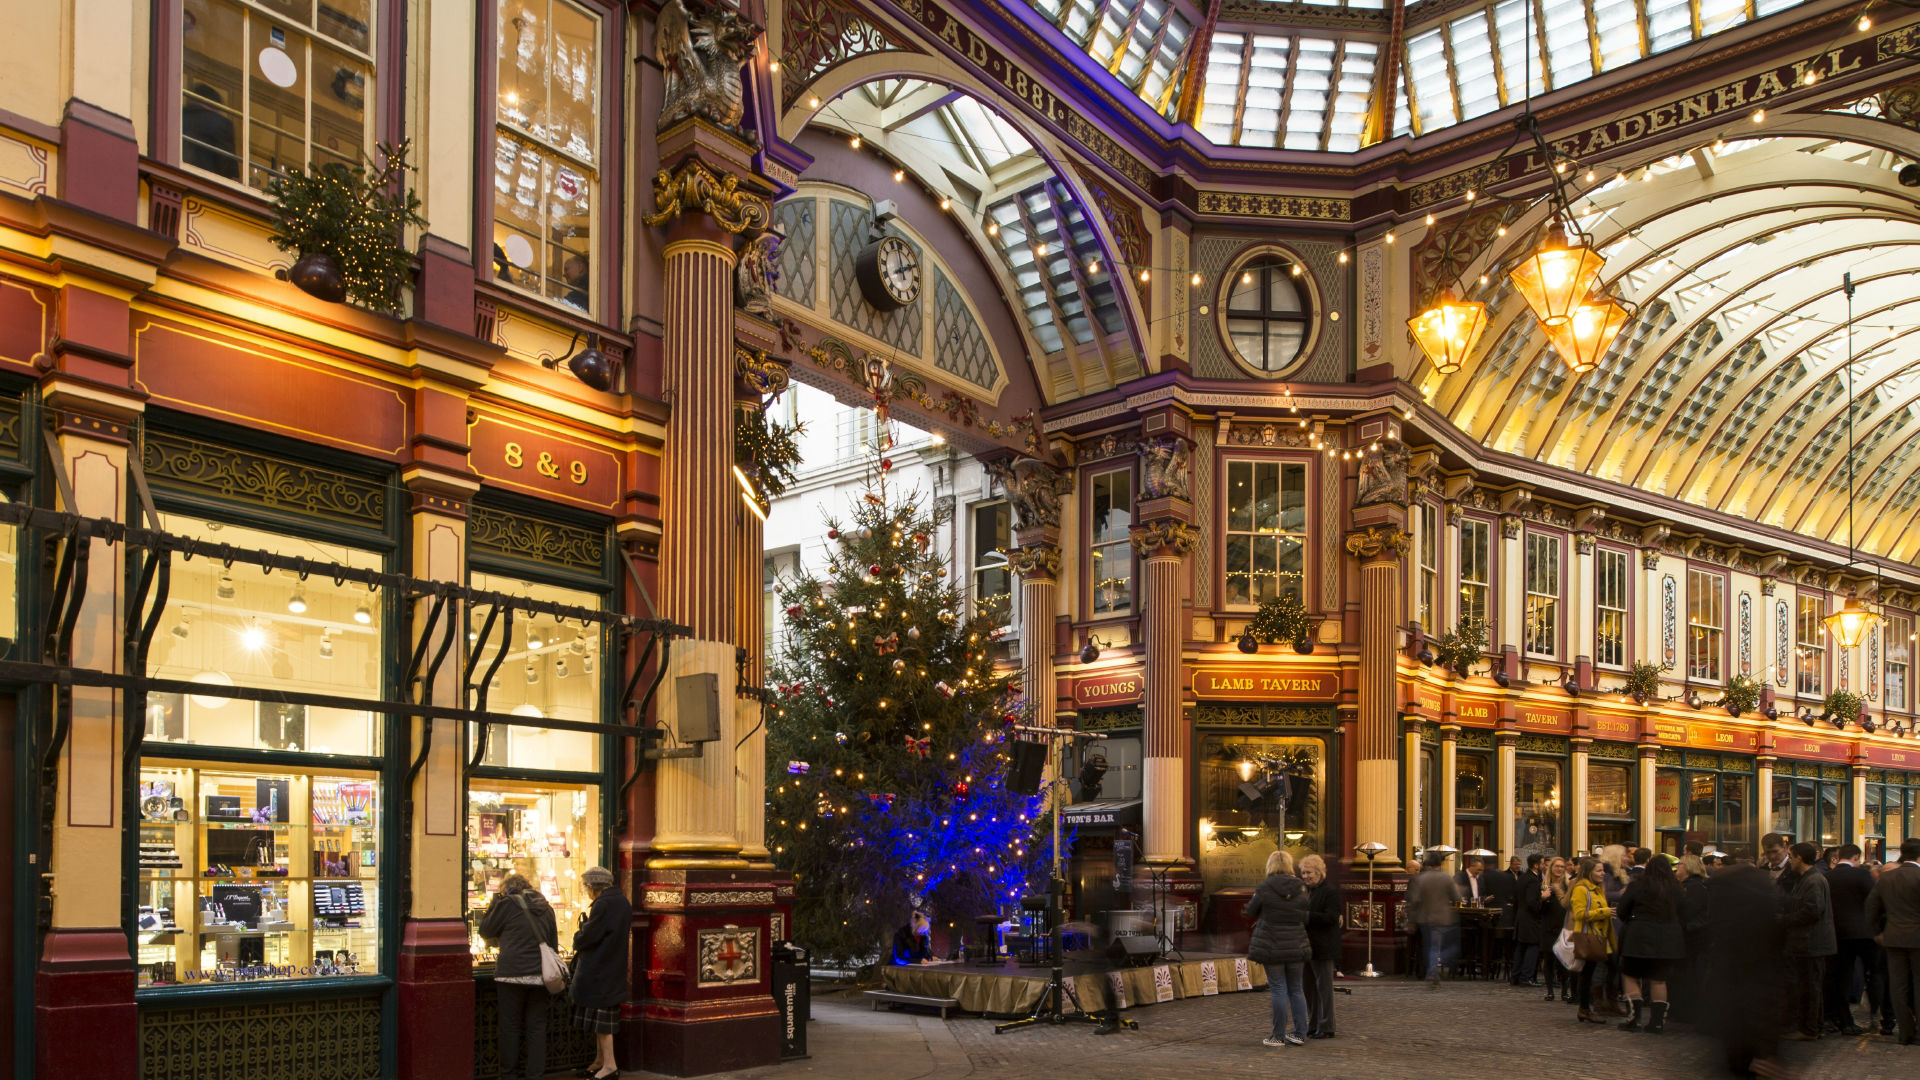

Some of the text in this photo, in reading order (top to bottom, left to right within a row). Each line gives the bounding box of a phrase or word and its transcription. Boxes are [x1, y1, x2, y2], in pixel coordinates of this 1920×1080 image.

[1003, 60, 1056, 122] 1881
[1523, 48, 1862, 174] LEADENHALL
[504, 442, 588, 485] 8 & 9
[1084, 681, 1136, 698] YOUNGS
[1210, 677, 1322, 692] LAMB TAVERN
[1460, 705, 1489, 718] LAMB
[1525, 712, 1559, 726] TAVERN
[1715, 733, 1734, 743] LEON
[1749, 737, 1757, 746] 13
[1804, 743, 1820, 753] LEON
[1891, 753, 1906, 761] LEON
[1066, 814, 1115, 824] TOM'S BAR
[184, 959, 340, 981] www.penshop.co.uk
